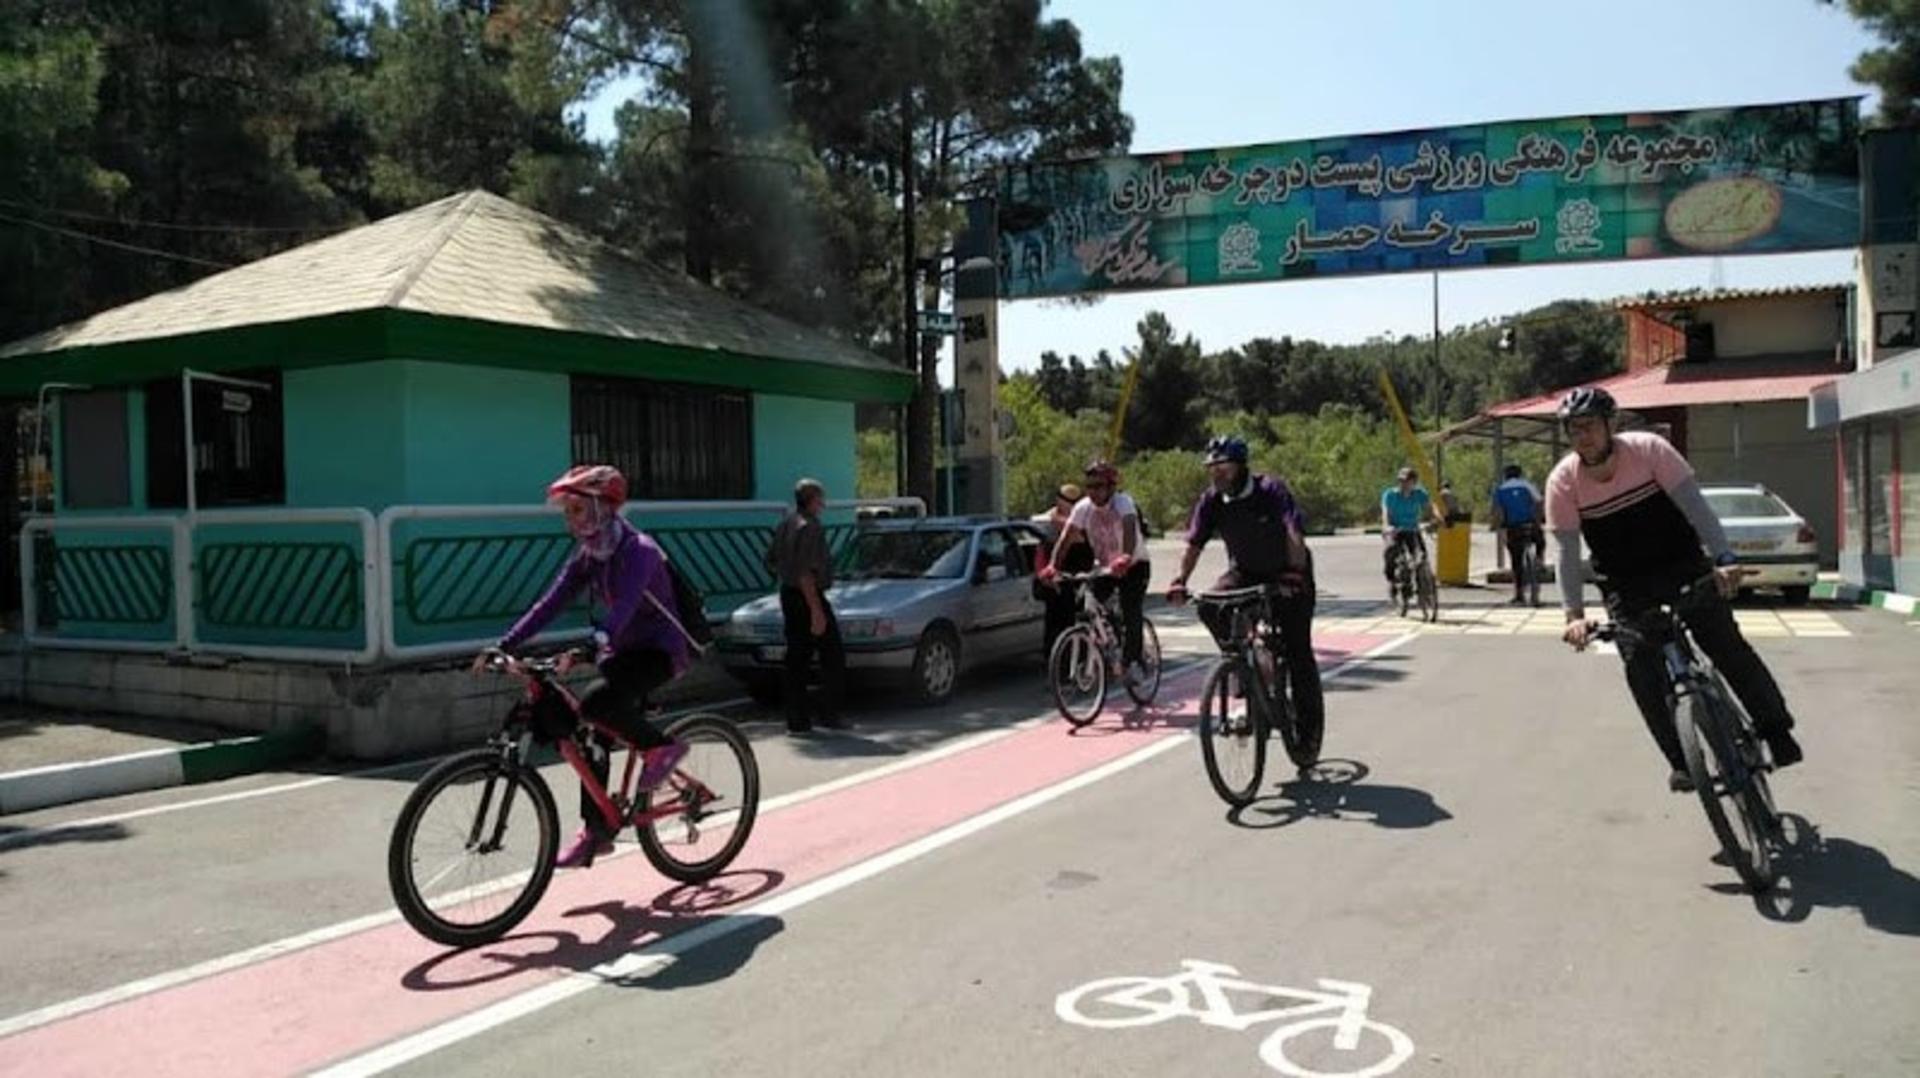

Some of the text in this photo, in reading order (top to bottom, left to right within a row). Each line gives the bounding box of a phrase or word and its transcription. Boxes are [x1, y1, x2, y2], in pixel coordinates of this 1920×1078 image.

[1111, 127, 1716, 214] مجموعه فرهنگی ورزشی پیست دوچرخه سواری
[1280, 210, 1538, 264] سرخه حصار
